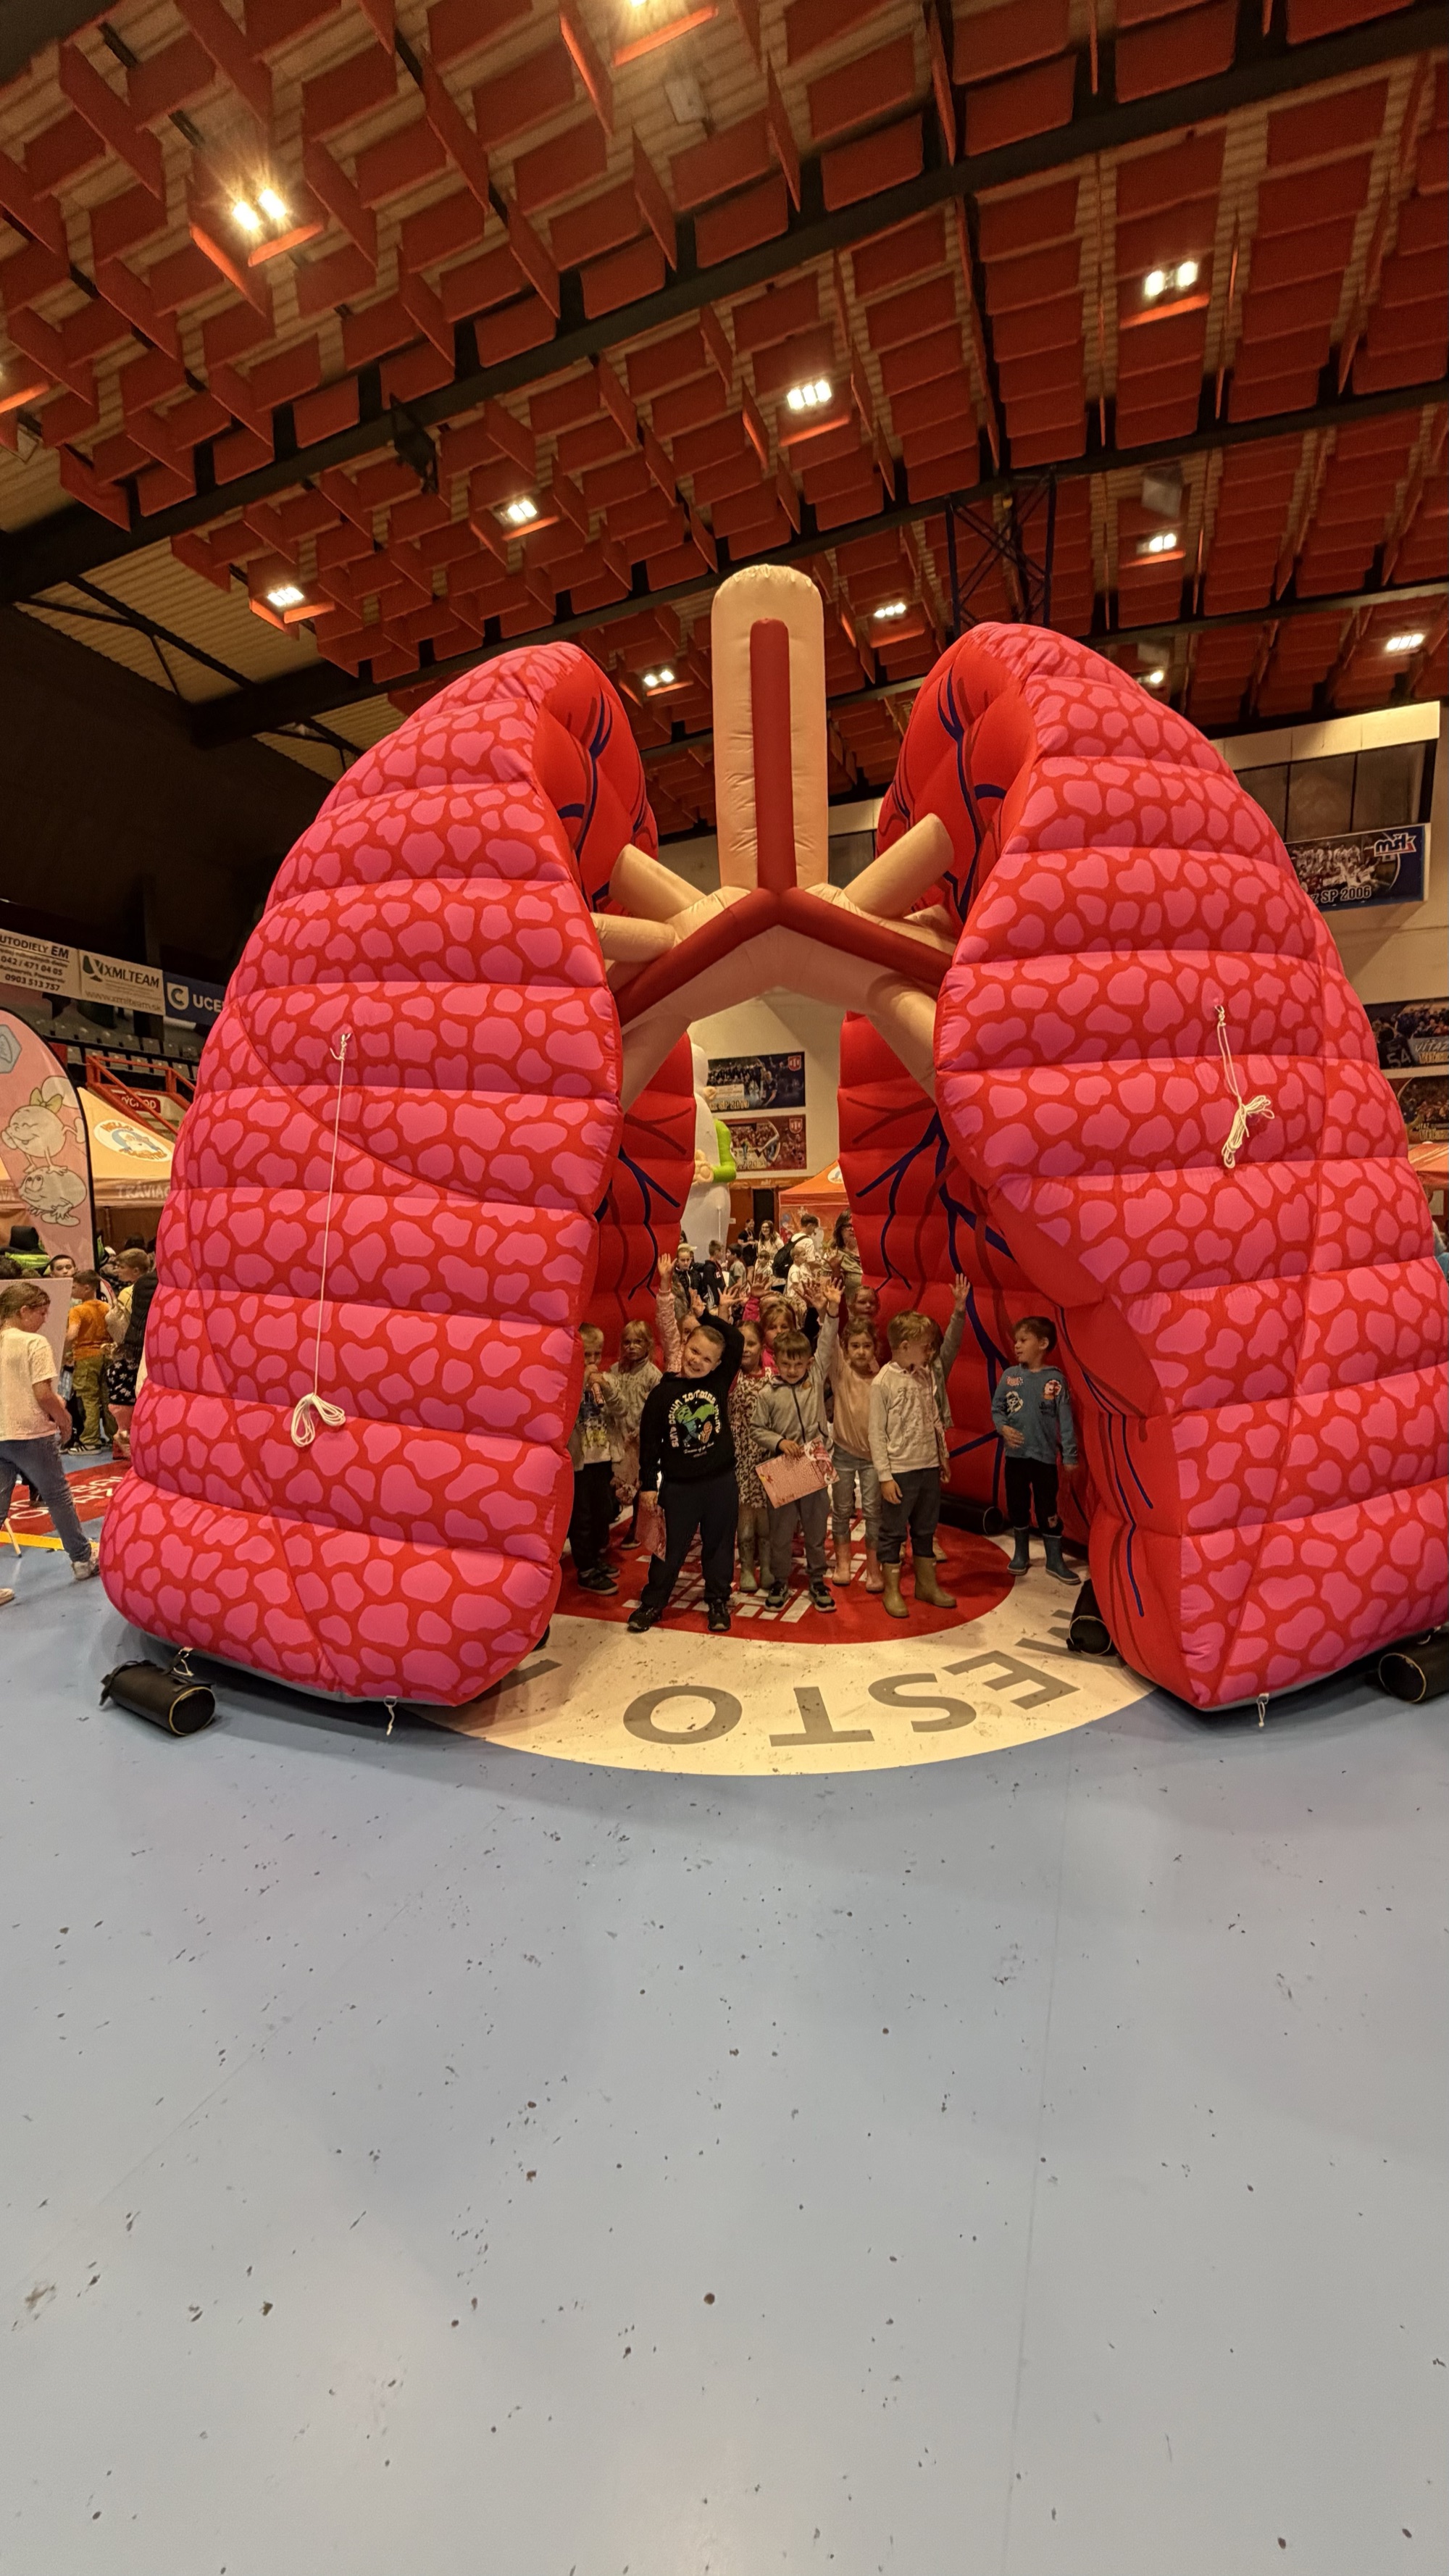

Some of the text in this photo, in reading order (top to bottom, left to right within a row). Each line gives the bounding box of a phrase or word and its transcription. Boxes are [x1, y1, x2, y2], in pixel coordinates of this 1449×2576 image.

[1321, 889, 1339, 903] SP
[1340, 885, 1371, 901] 2006
[51, 945, 69, 959] EM
[1, 956, 17, 965] 042
[24, 961, 39, 970] 471
[5, 973, 60, 991] 0903 513 757
[104, 966, 159, 988] XMLTEAM
[193, 993, 224, 1013] UCE
